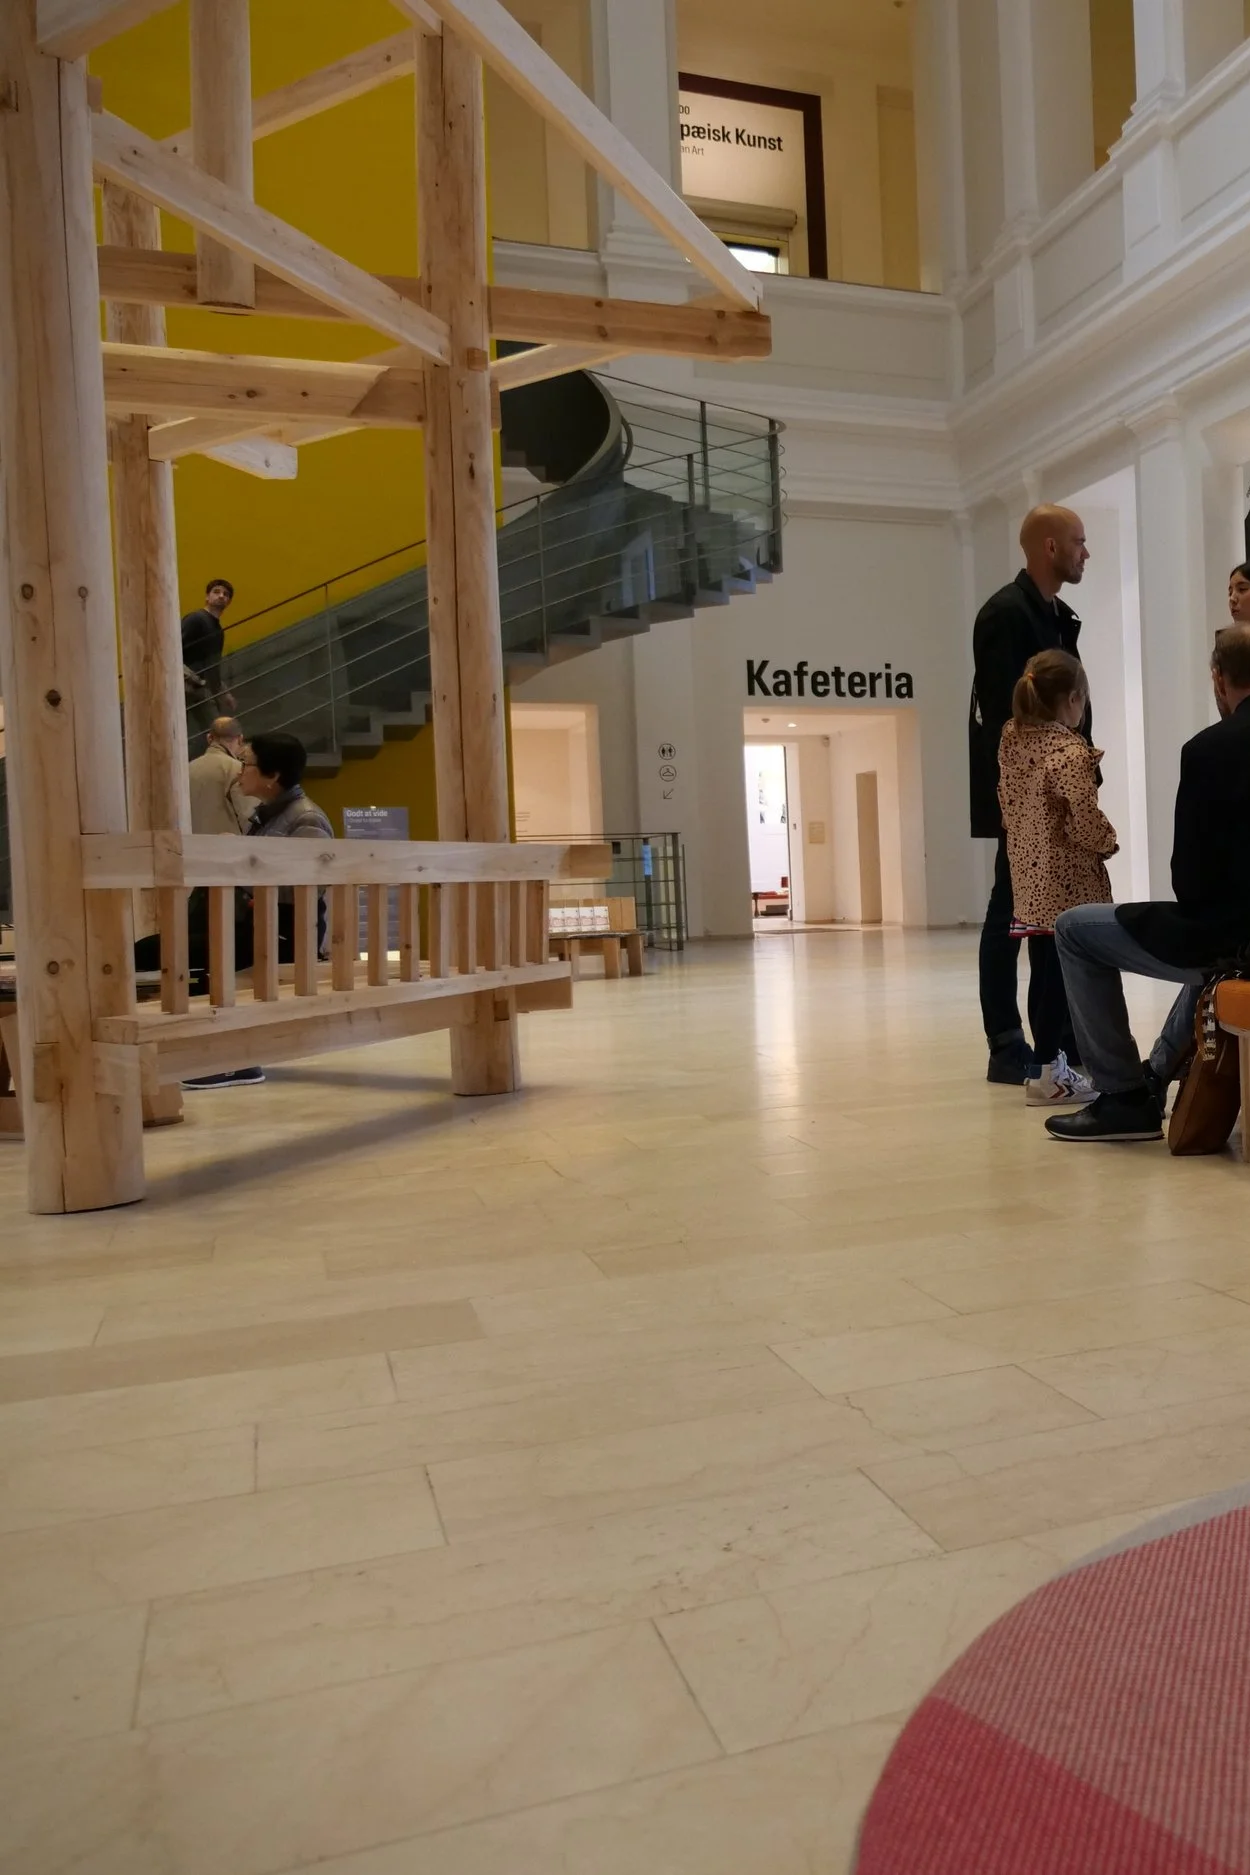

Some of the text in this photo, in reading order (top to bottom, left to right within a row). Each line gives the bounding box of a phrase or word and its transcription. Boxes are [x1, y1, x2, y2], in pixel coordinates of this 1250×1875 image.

[680, 123, 784, 152] pæisk Kunst
[692, 145, 704, 156] Art
[746, 659, 914, 699] Kafeteria
